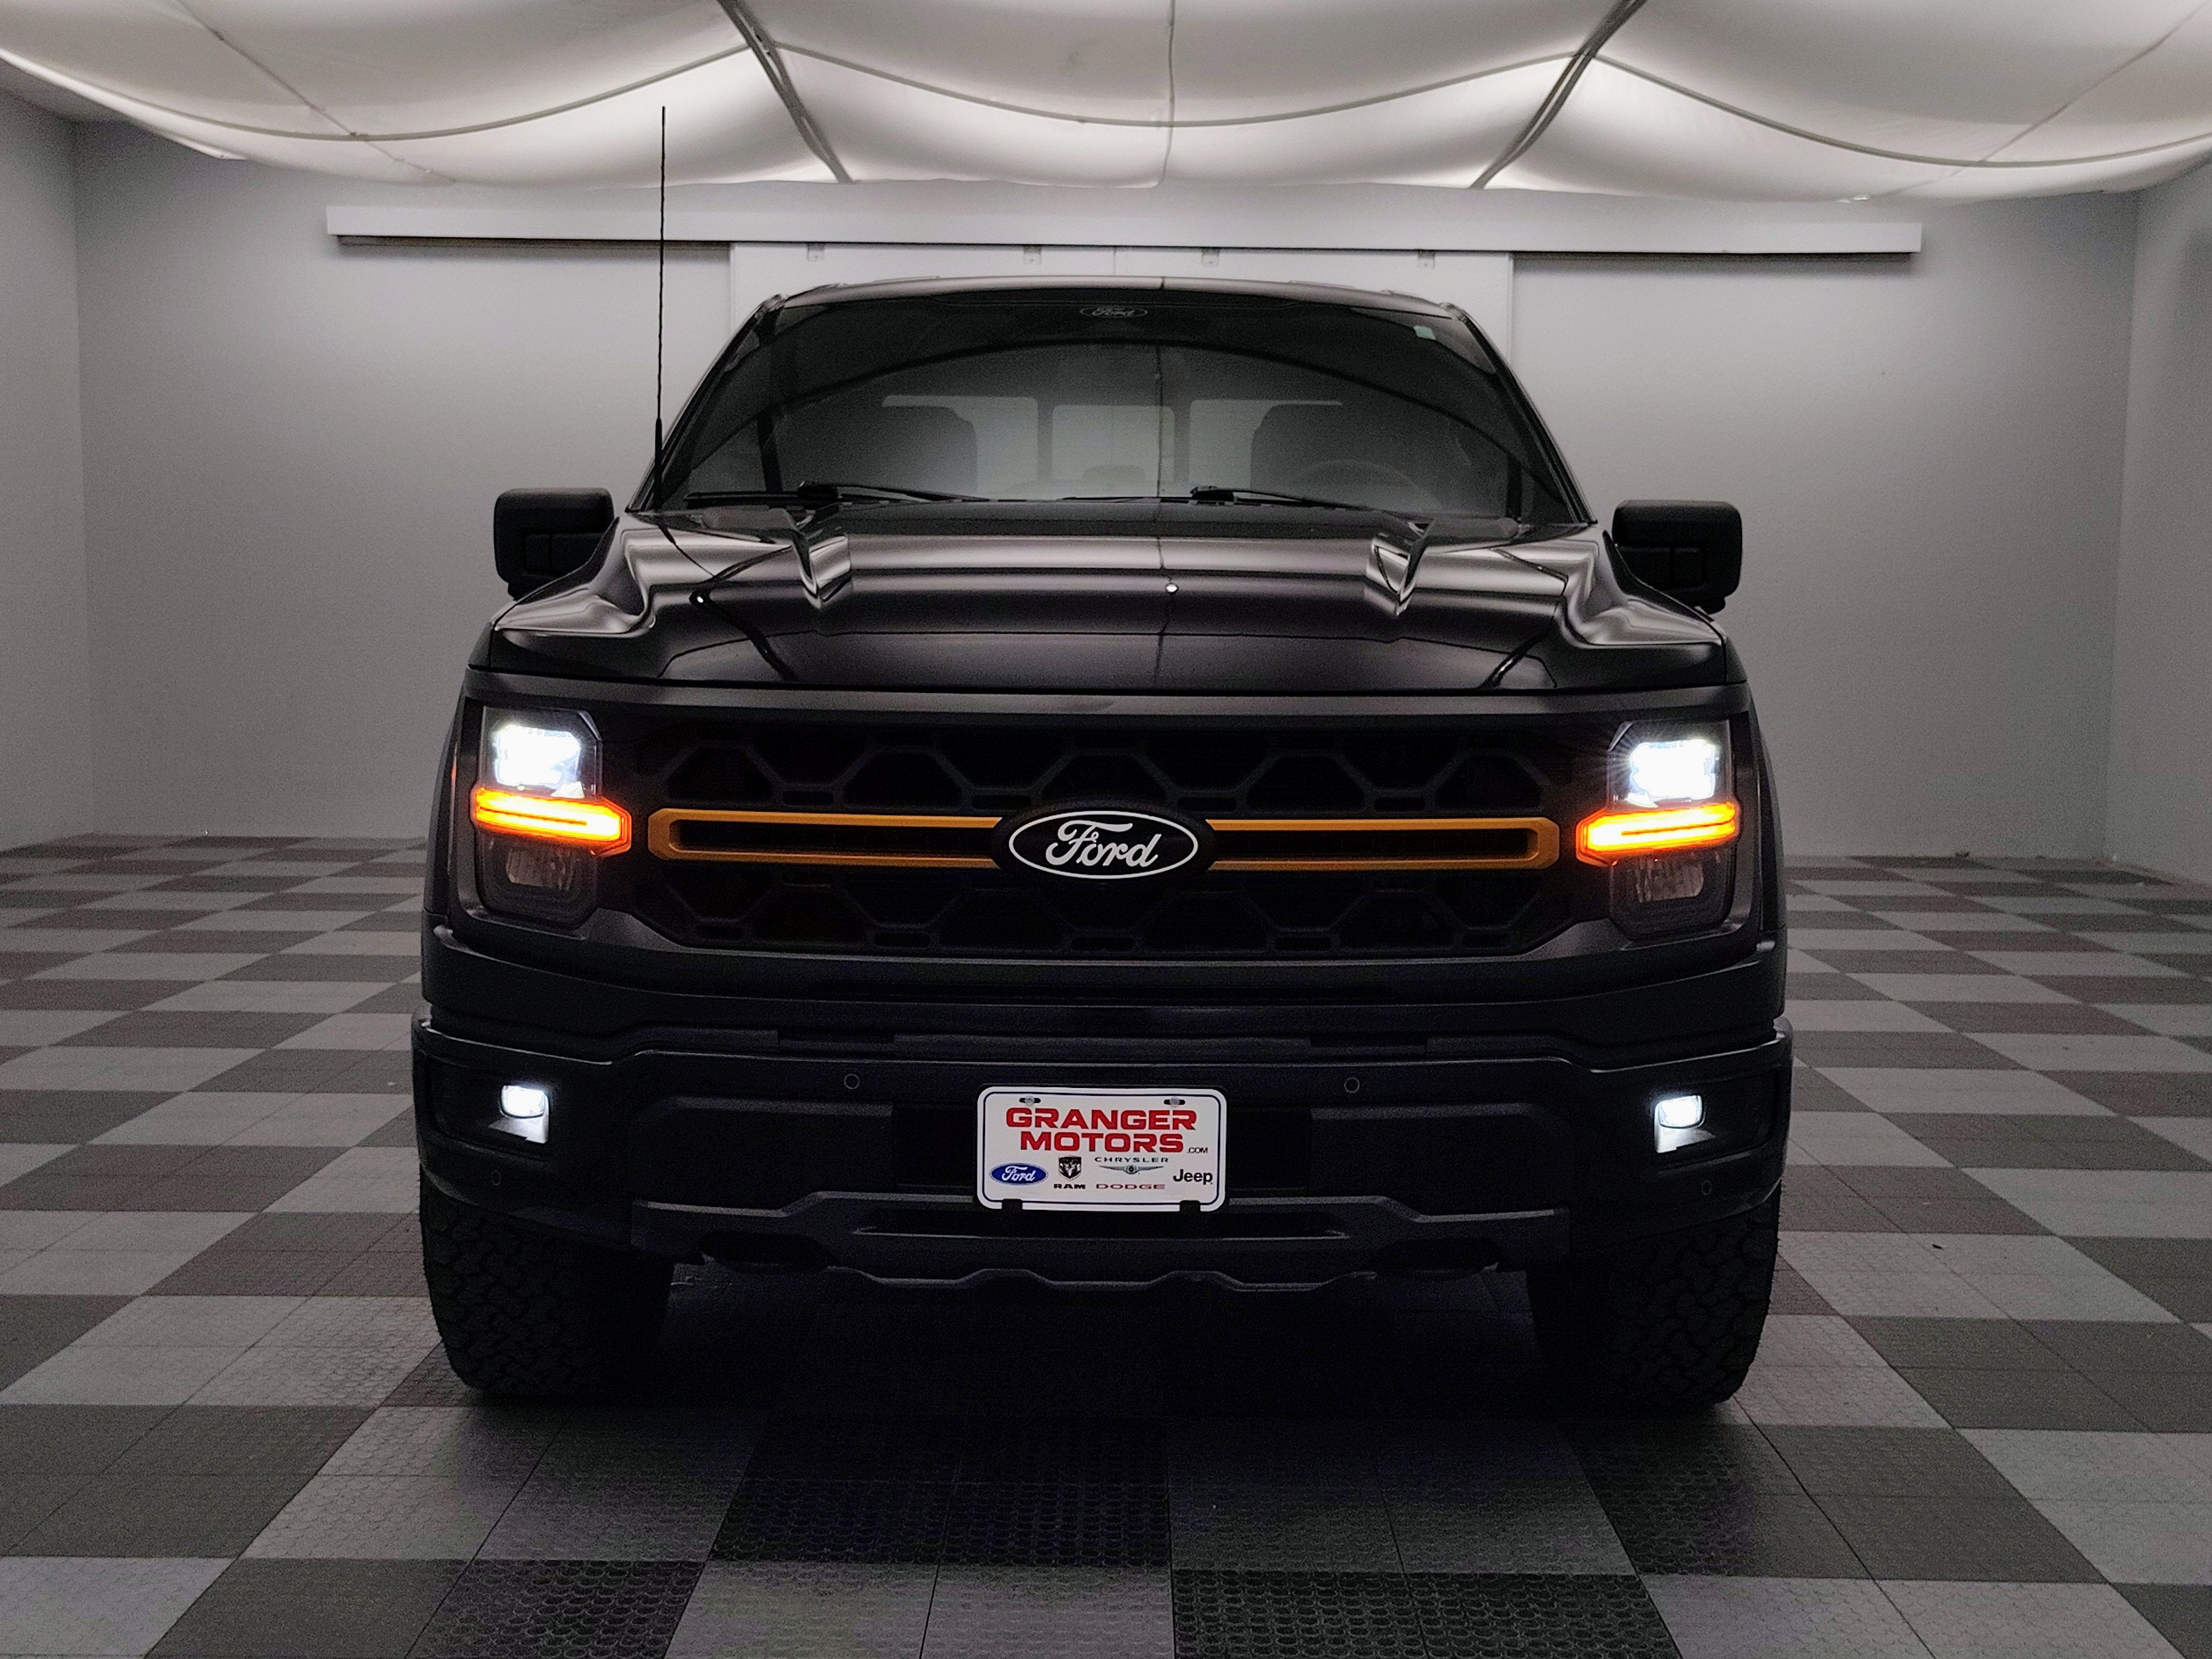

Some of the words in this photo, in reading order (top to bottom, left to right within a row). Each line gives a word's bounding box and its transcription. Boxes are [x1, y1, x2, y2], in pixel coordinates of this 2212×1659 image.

[1046, 819, 1162, 867] Ford
[1006, 1107, 1197, 1130] GRANGER
[1020, 1131, 1184, 1153] MOTORS
[1001, 1165, 1037, 1182] Ford
[1173, 1169, 1213, 1185] Jeep
